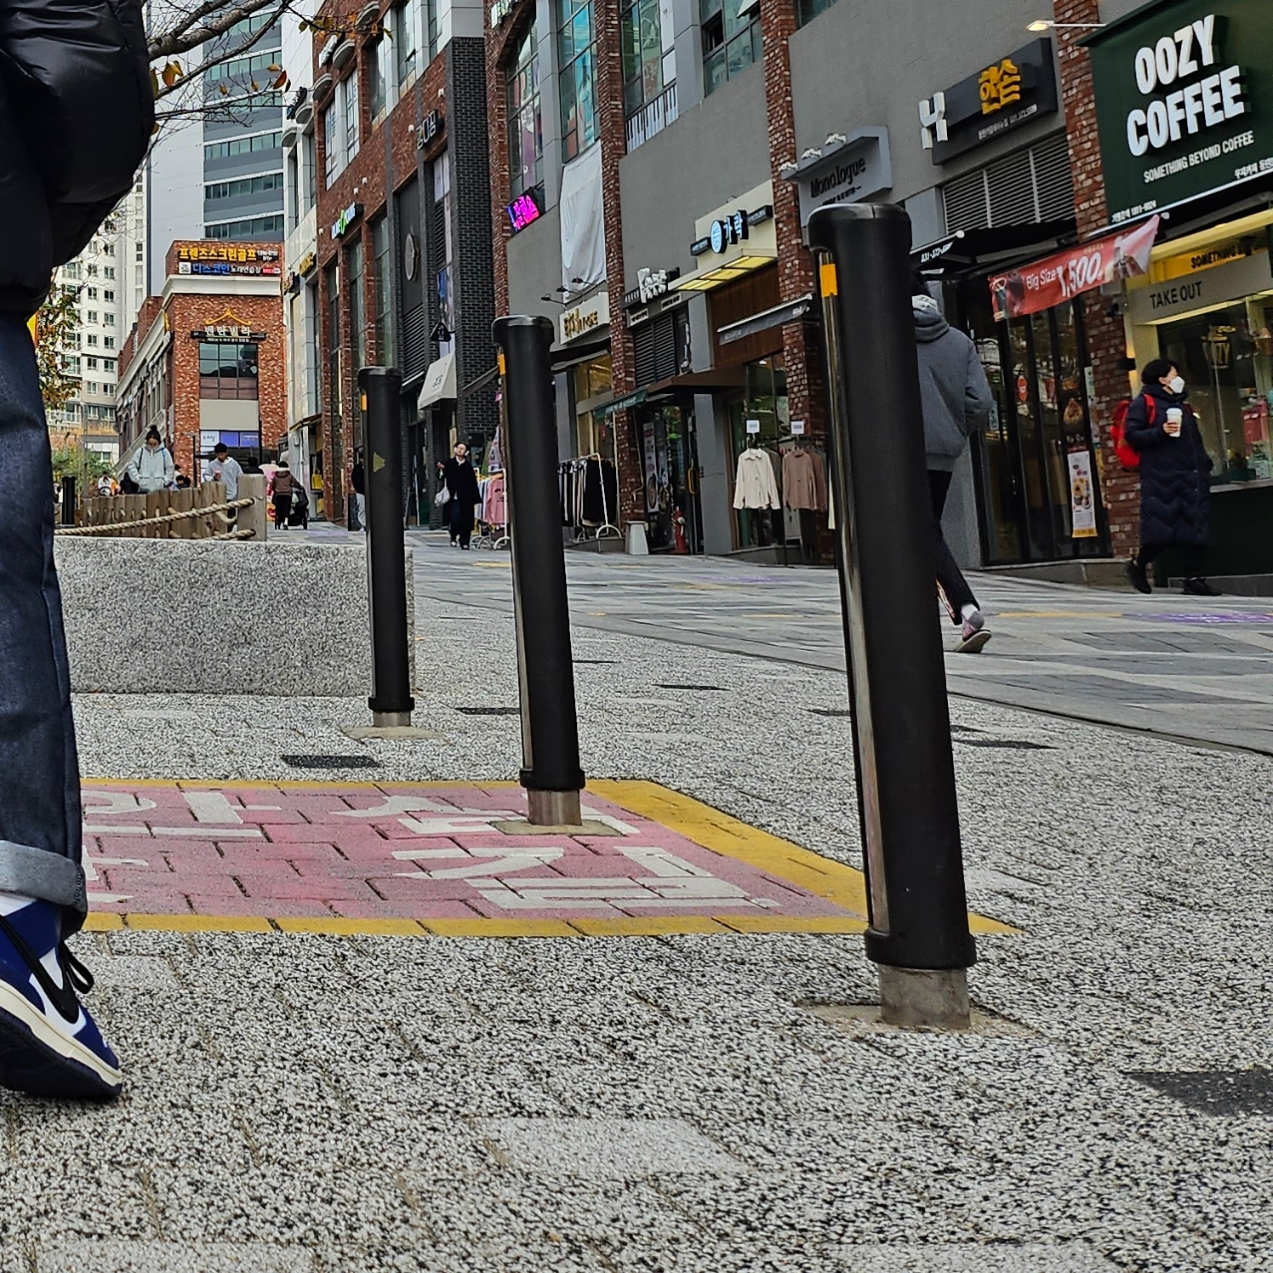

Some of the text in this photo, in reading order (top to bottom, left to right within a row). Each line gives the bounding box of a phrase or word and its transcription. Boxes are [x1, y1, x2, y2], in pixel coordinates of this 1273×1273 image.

[1134, 13, 1218, 95] OOZY
[1126, 65, 1246, 158] COFFEE
[810, 157, 867, 199] Monologue
[1143, 130, 1255, 184] SOMETHING BEYOND COFFEE
[179, 247, 258, 262] 프렌즈스크린골프
[1149, 281, 1203, 311] TAKE OUT
